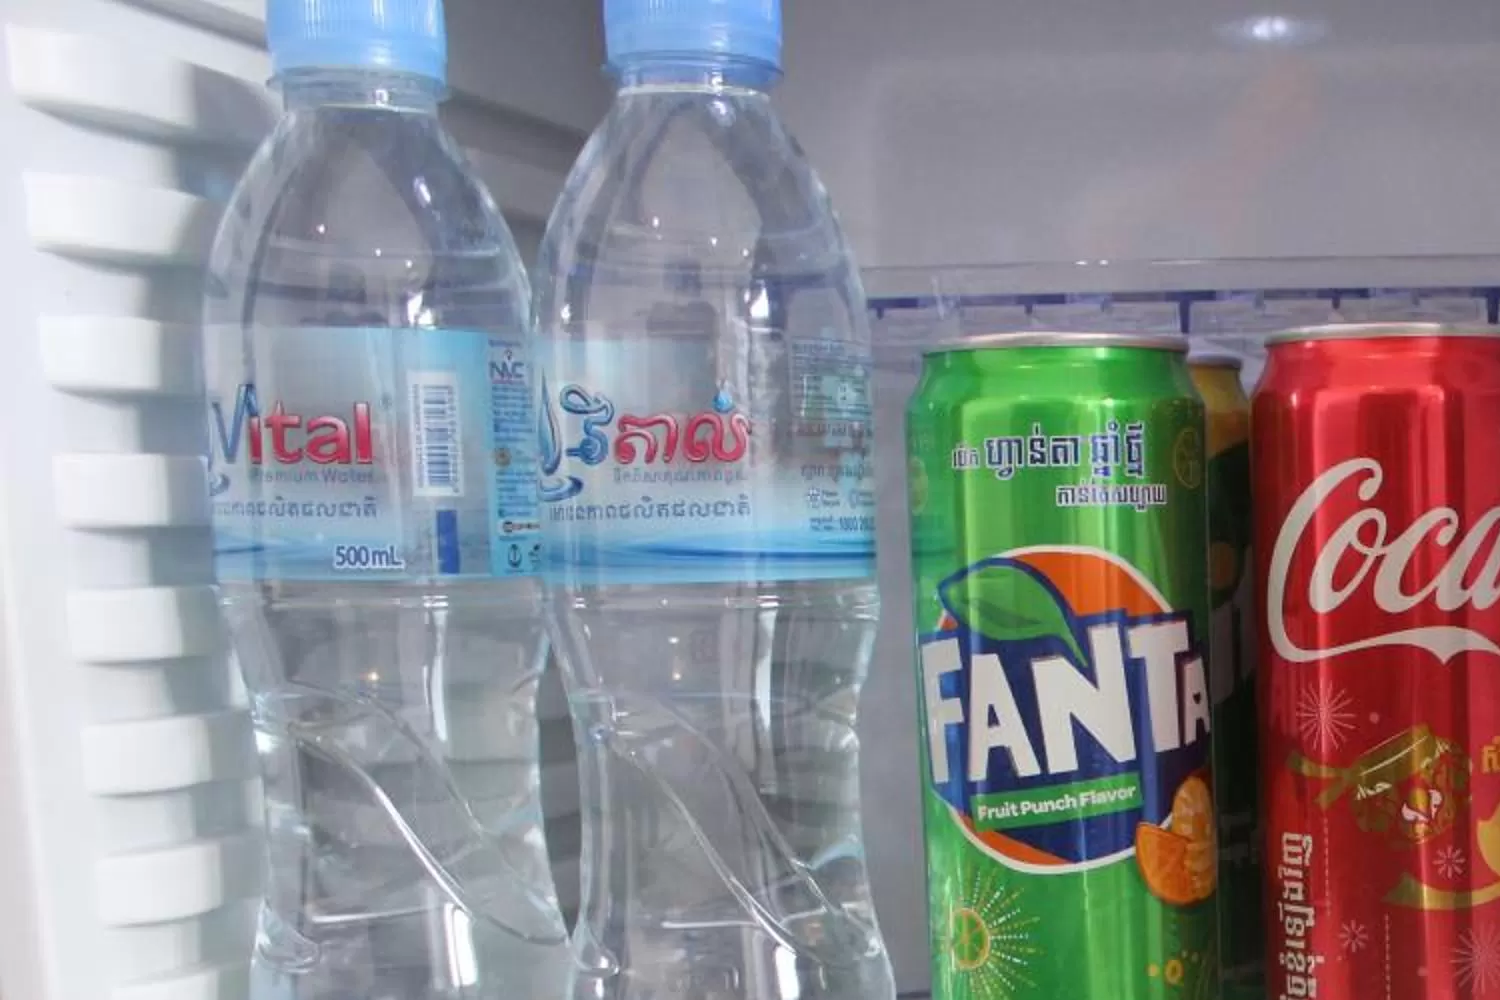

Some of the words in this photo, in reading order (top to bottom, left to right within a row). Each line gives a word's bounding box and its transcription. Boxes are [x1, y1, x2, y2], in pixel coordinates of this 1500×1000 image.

[211, 383, 373, 465] Vital
[921, 620, 1211, 784] FANTA
[977, 802, 1019, 821] Fruit
[1020, 793, 1077, 815] Punch
[1079, 785, 1137, 807] Flavor
